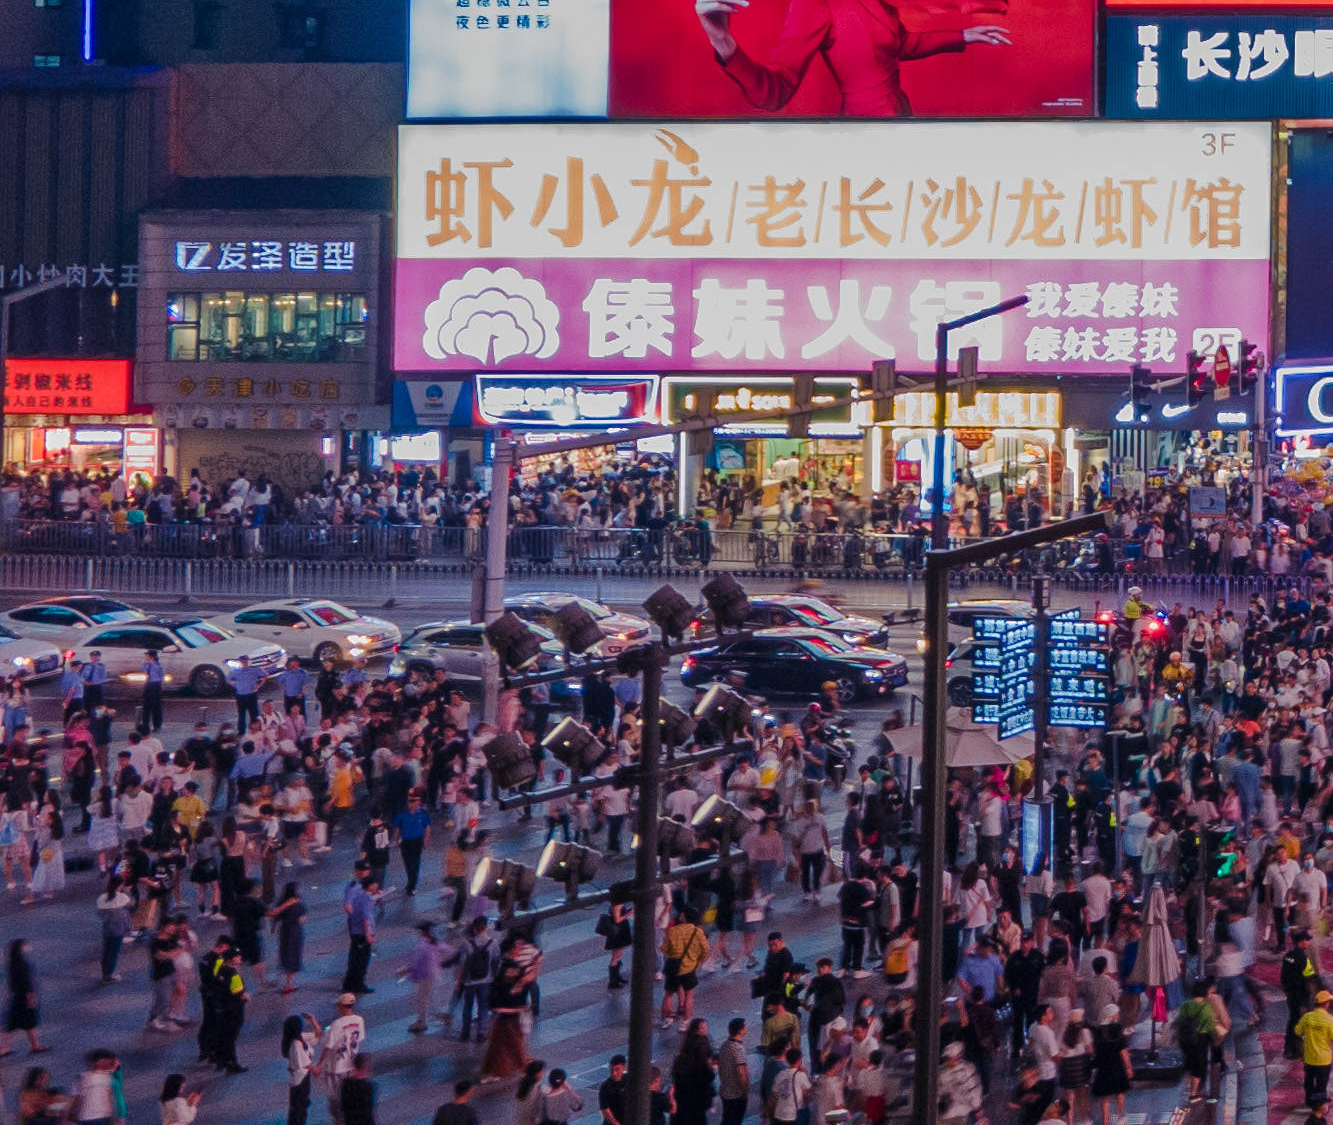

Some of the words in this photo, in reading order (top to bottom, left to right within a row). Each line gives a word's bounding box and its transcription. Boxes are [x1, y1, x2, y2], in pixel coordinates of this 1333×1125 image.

[456, 15, 551, 29] 夜色更精彩
[1201, 131, 1237, 157] 3F
[423, 151, 714, 249] 虾小龙
[216, 241, 356, 271] 发泽造型
[0, 263, 140, 289] 小炒肉大王
[1025, 280, 1179, 320] 我爱傣妹
[582, 277, 1004, 361] 傣妹火锅
[1025, 324, 1177, 363] 傣妹爱我
